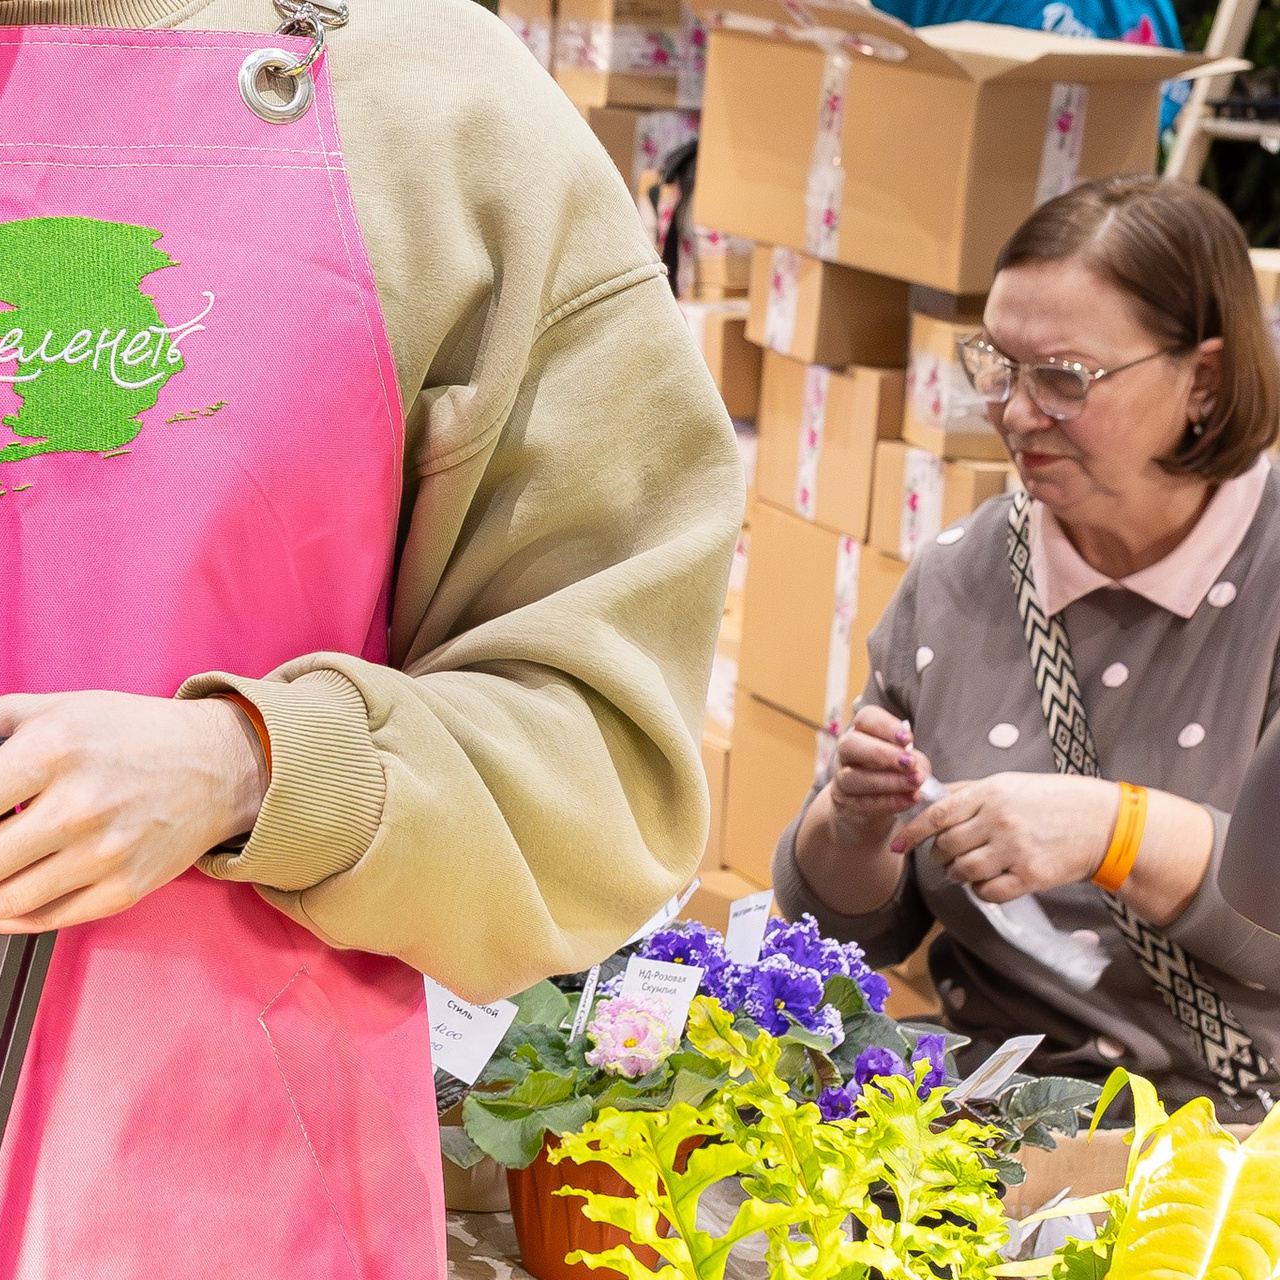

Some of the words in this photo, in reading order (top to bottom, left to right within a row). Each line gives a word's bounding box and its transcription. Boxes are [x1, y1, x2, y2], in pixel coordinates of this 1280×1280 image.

[638, 968, 687, 983] НД-Розовая
[447, 999, 473, 1020] Стиль
[432, 1022, 463, 1041] 1200
